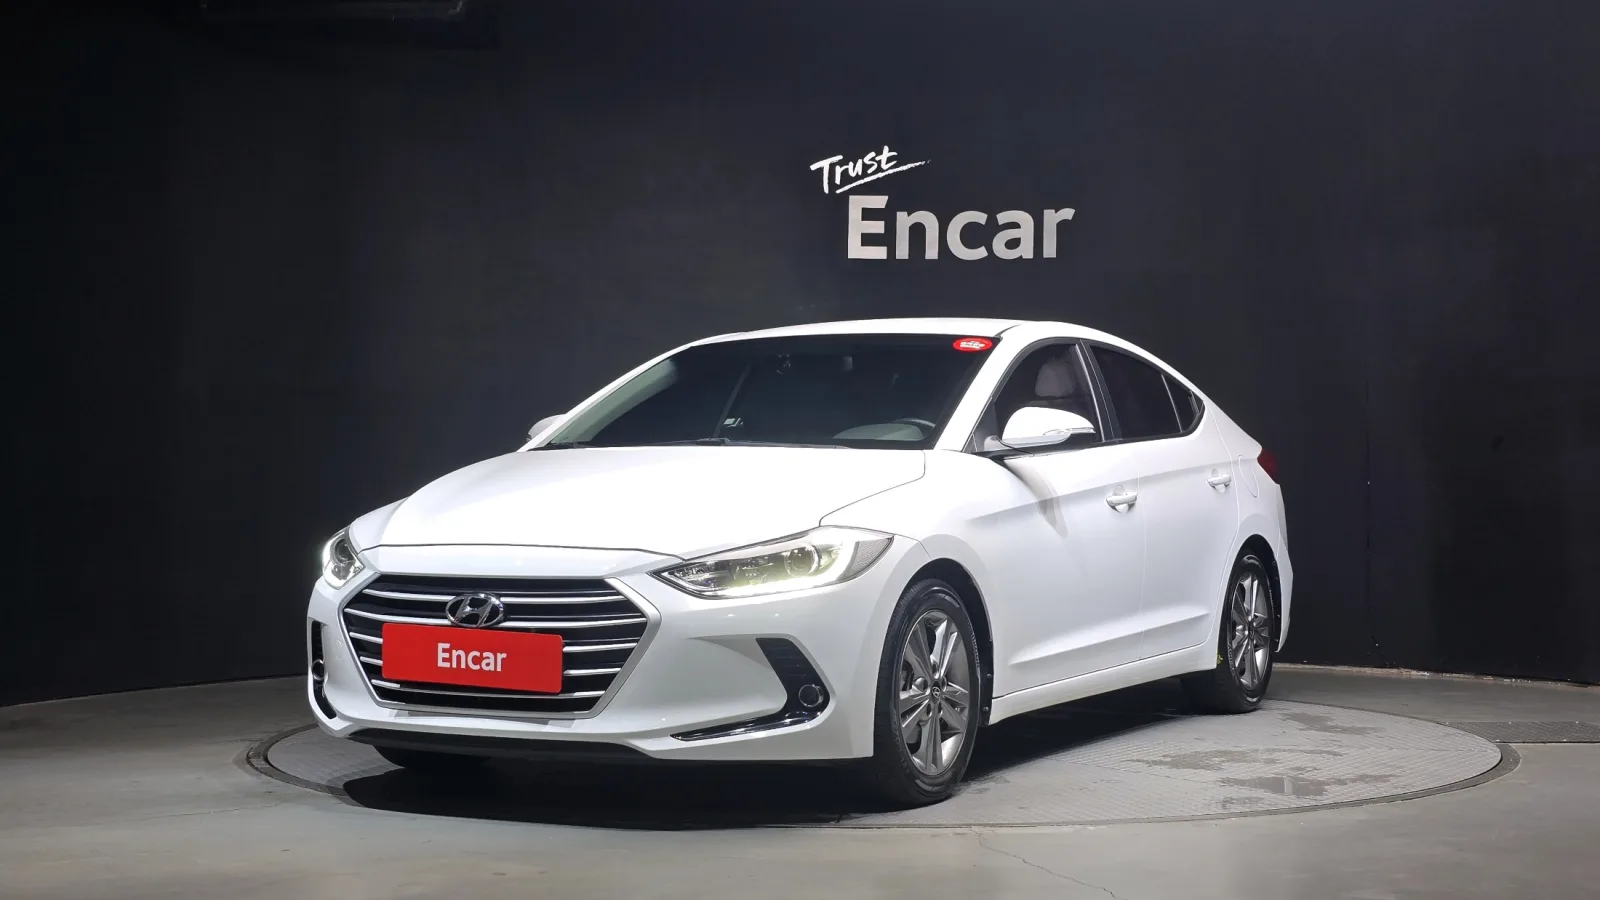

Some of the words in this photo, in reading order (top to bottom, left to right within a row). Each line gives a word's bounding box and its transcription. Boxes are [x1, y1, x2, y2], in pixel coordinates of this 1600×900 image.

[810, 146, 898, 194] Trust
[847, 194, 1076, 260] Encar
[436, 642, 507, 672] Encar
